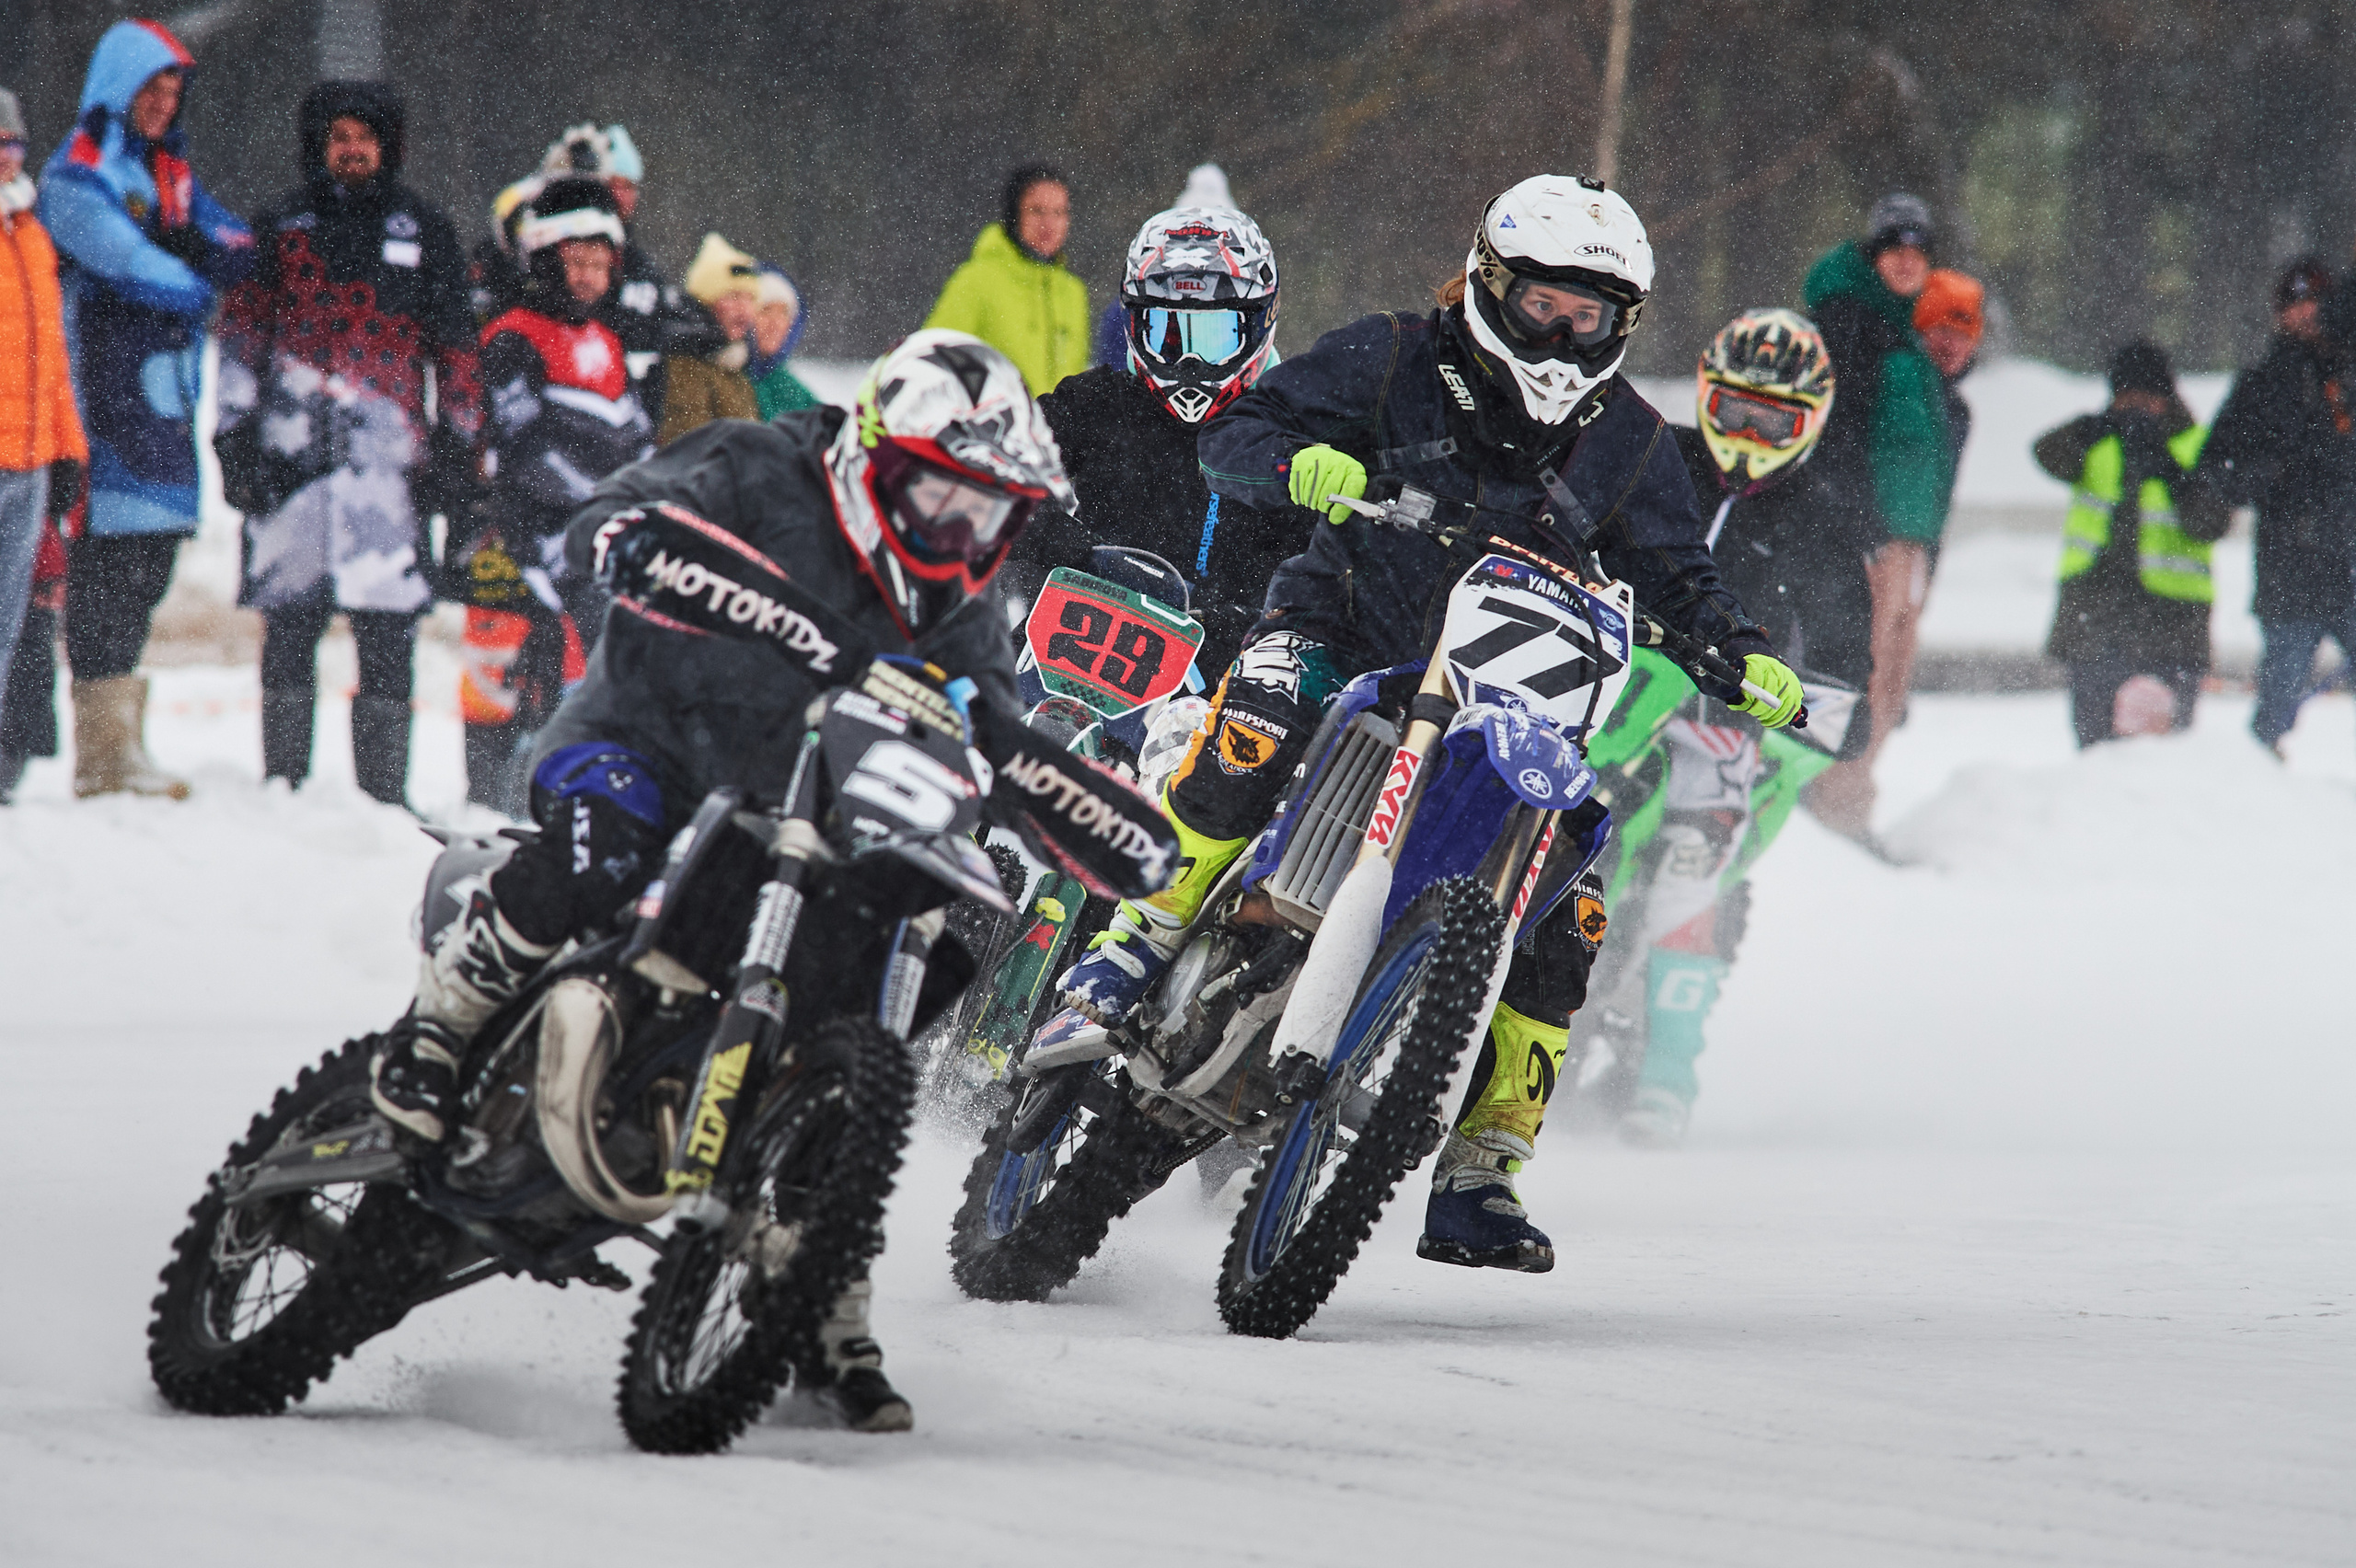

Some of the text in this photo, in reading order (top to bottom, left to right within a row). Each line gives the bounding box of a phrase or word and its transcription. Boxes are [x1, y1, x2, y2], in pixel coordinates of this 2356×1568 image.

[1175, 281, 1205, 291] BELL
[1583, 245, 1628, 266] SHOEI
[644, 549, 840, 674] MOTOKIDZ
[1047, 600, 1166, 698] 29
[1449, 595, 1625, 700] 77
[842, 739, 967, 833] 5
